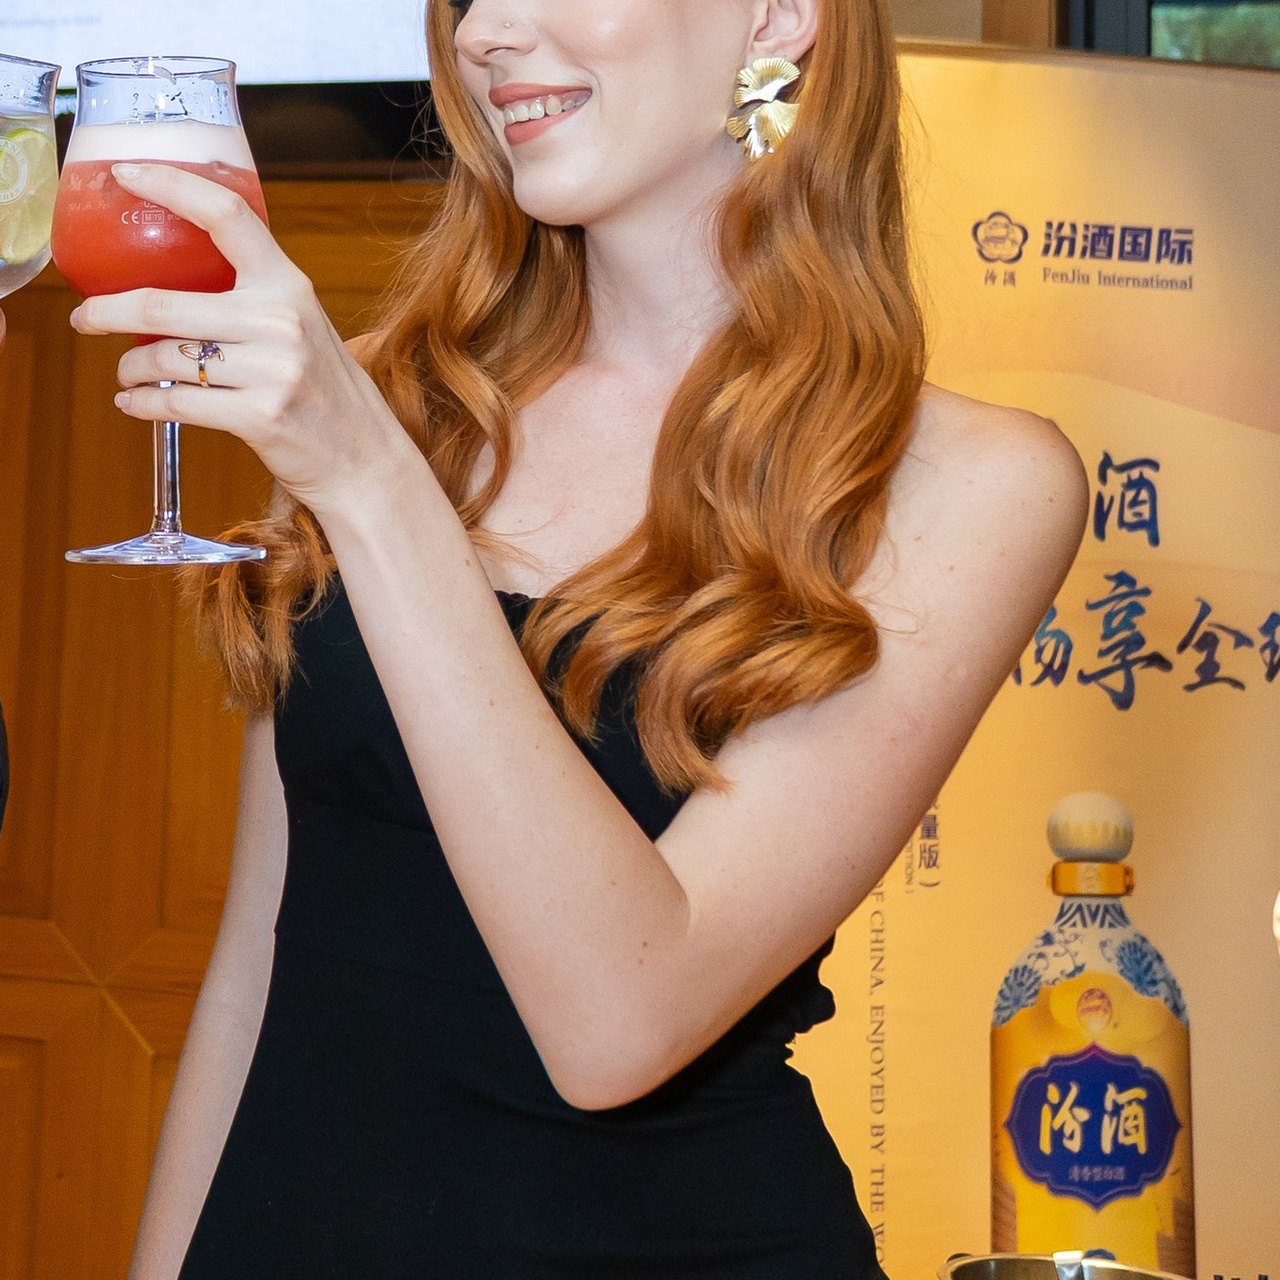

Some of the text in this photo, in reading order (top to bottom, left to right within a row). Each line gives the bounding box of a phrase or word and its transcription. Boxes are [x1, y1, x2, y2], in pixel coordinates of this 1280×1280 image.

[1041, 221, 1195, 265] 汾酒国际
[1042, 267, 1193, 291] FenJiu International
[1093, 451, 1161, 548] 酒
[866, 1005, 885, 1116] ENJOYED
[870, 1124, 885, 1154] BY
[1039, 1081, 1148, 1155] 汾酒
[870, 1163, 885, 1213] THE
